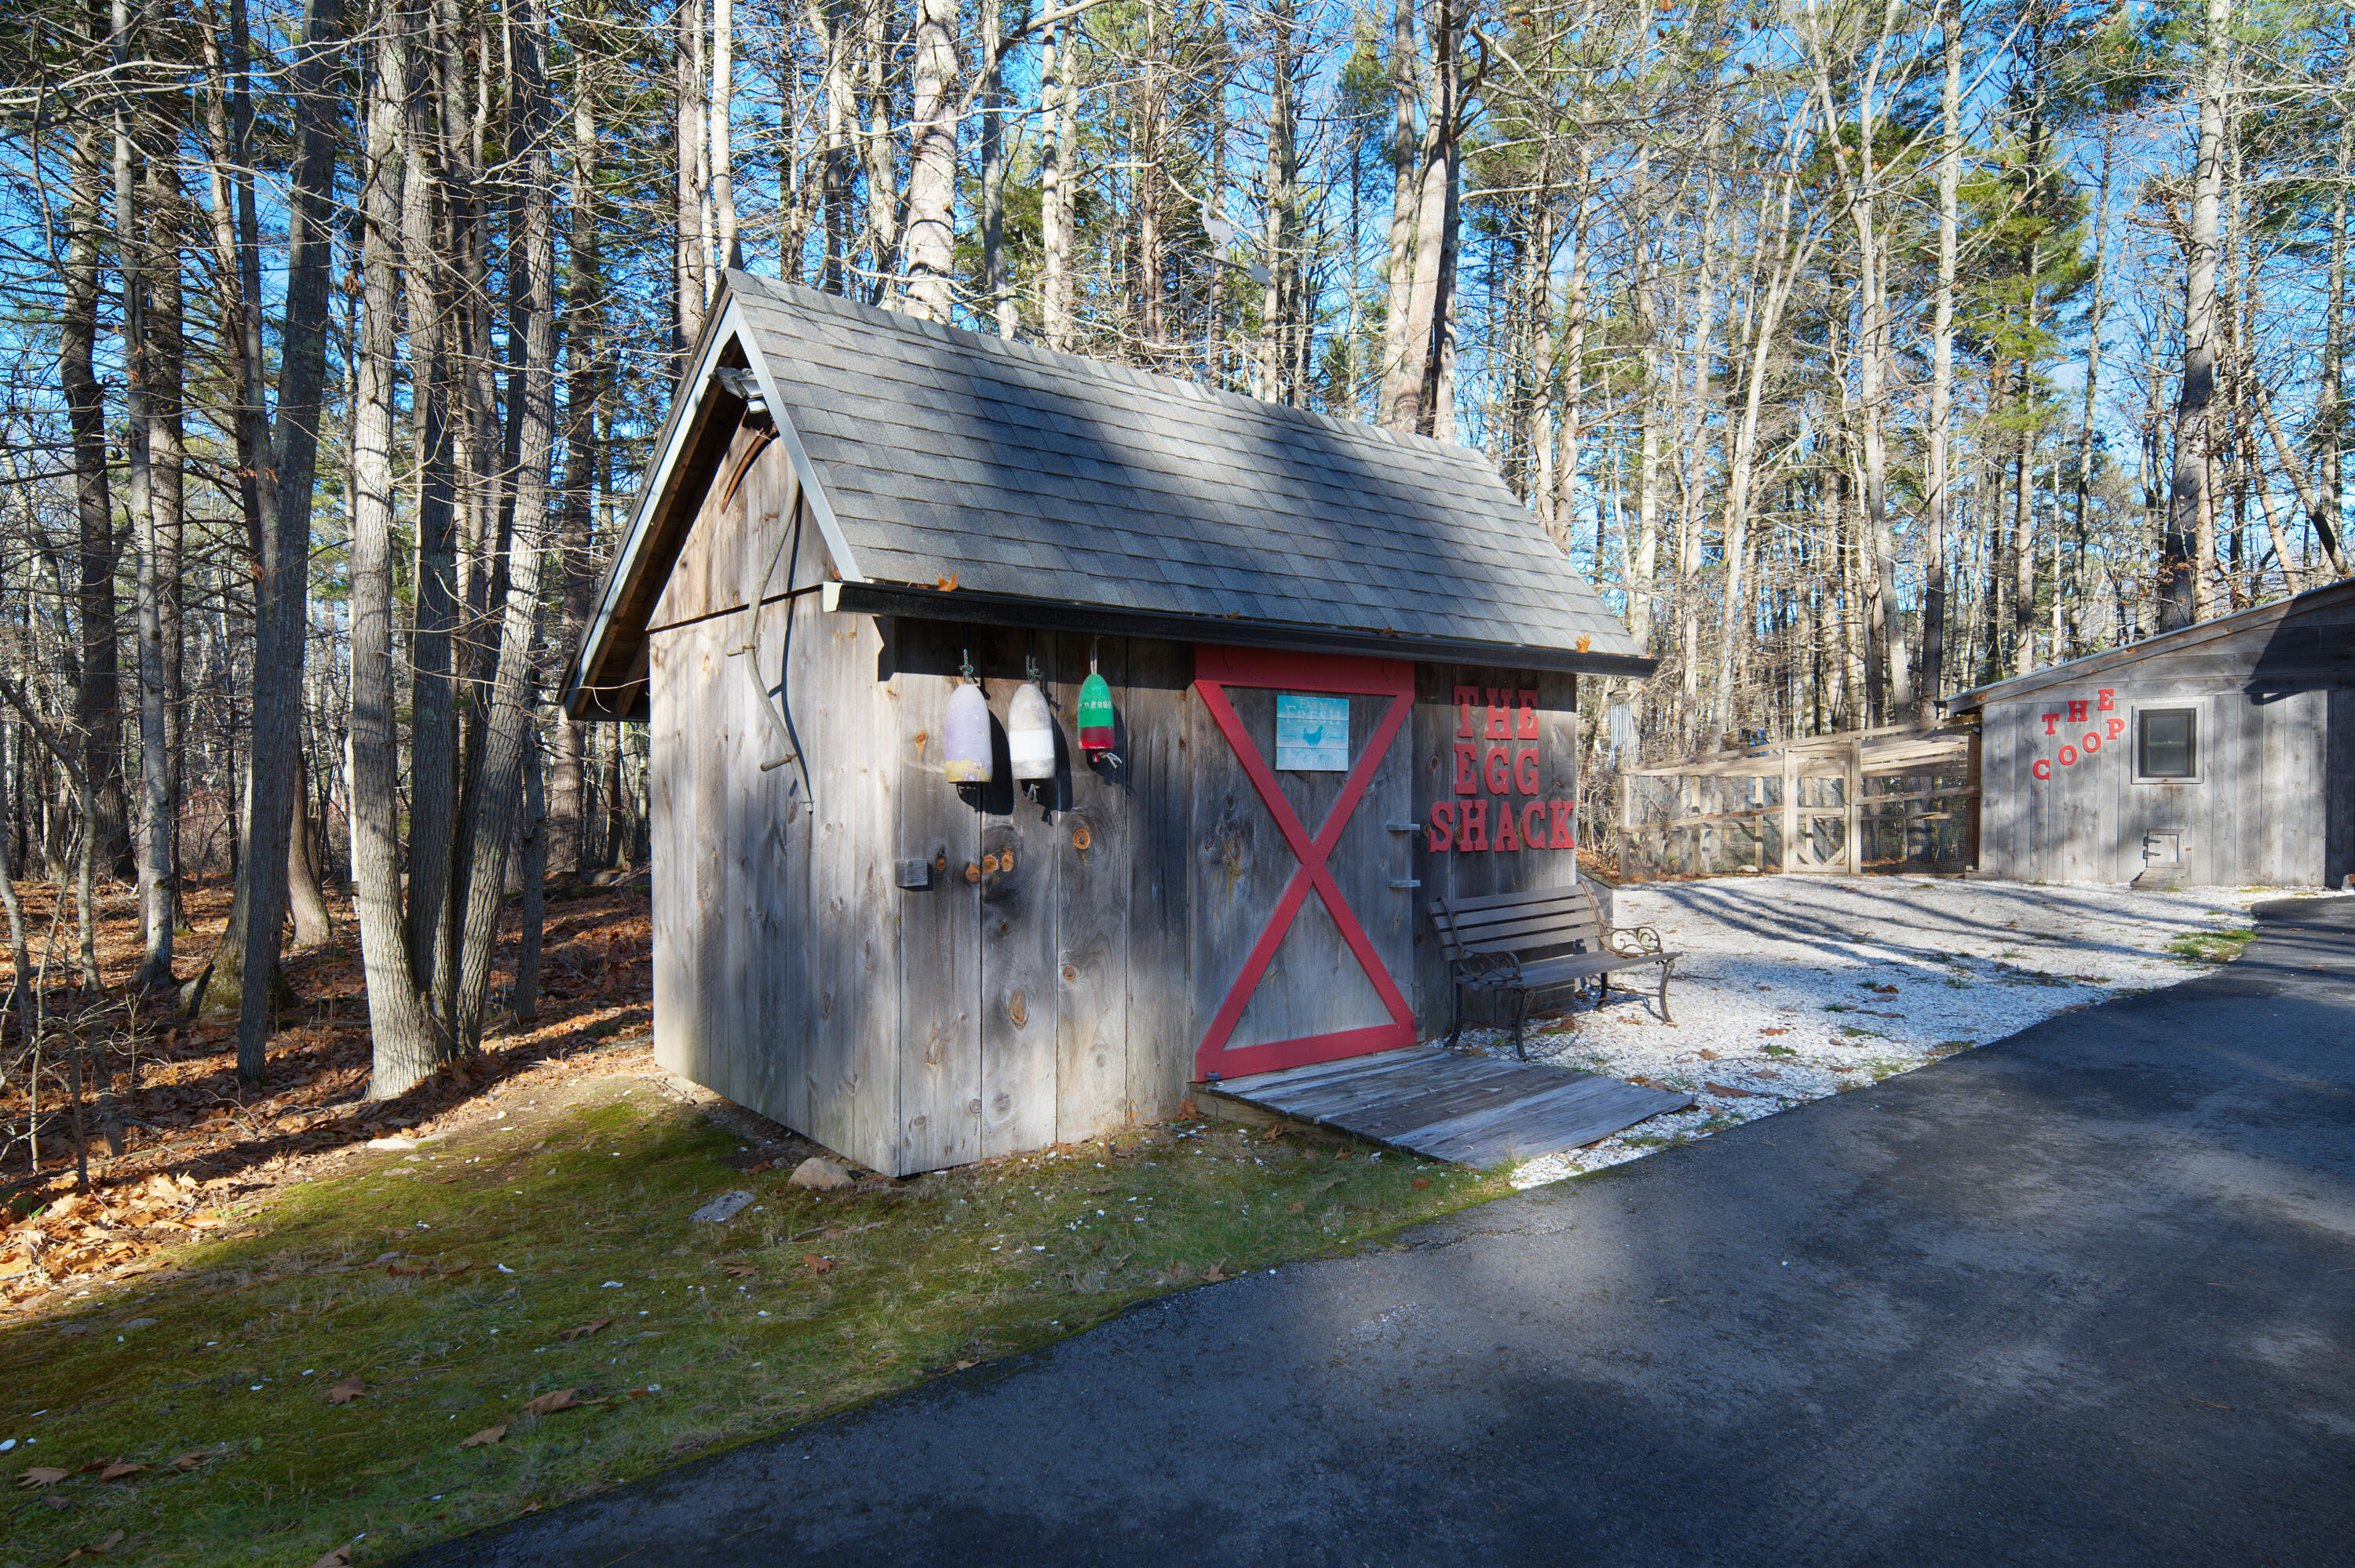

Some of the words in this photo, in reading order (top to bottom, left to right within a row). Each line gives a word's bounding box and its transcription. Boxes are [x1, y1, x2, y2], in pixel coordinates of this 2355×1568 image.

[1285, 703, 1342, 725] FRESH
[1299, 698, 1327, 709] FARM
[1453, 686, 1539, 740] THE
[2042, 688, 2114, 735] THE
[1454, 742, 1539, 796] EGG
[2033, 718, 2125, 779] COOP
[1429, 799, 1575, 853] SHACK
